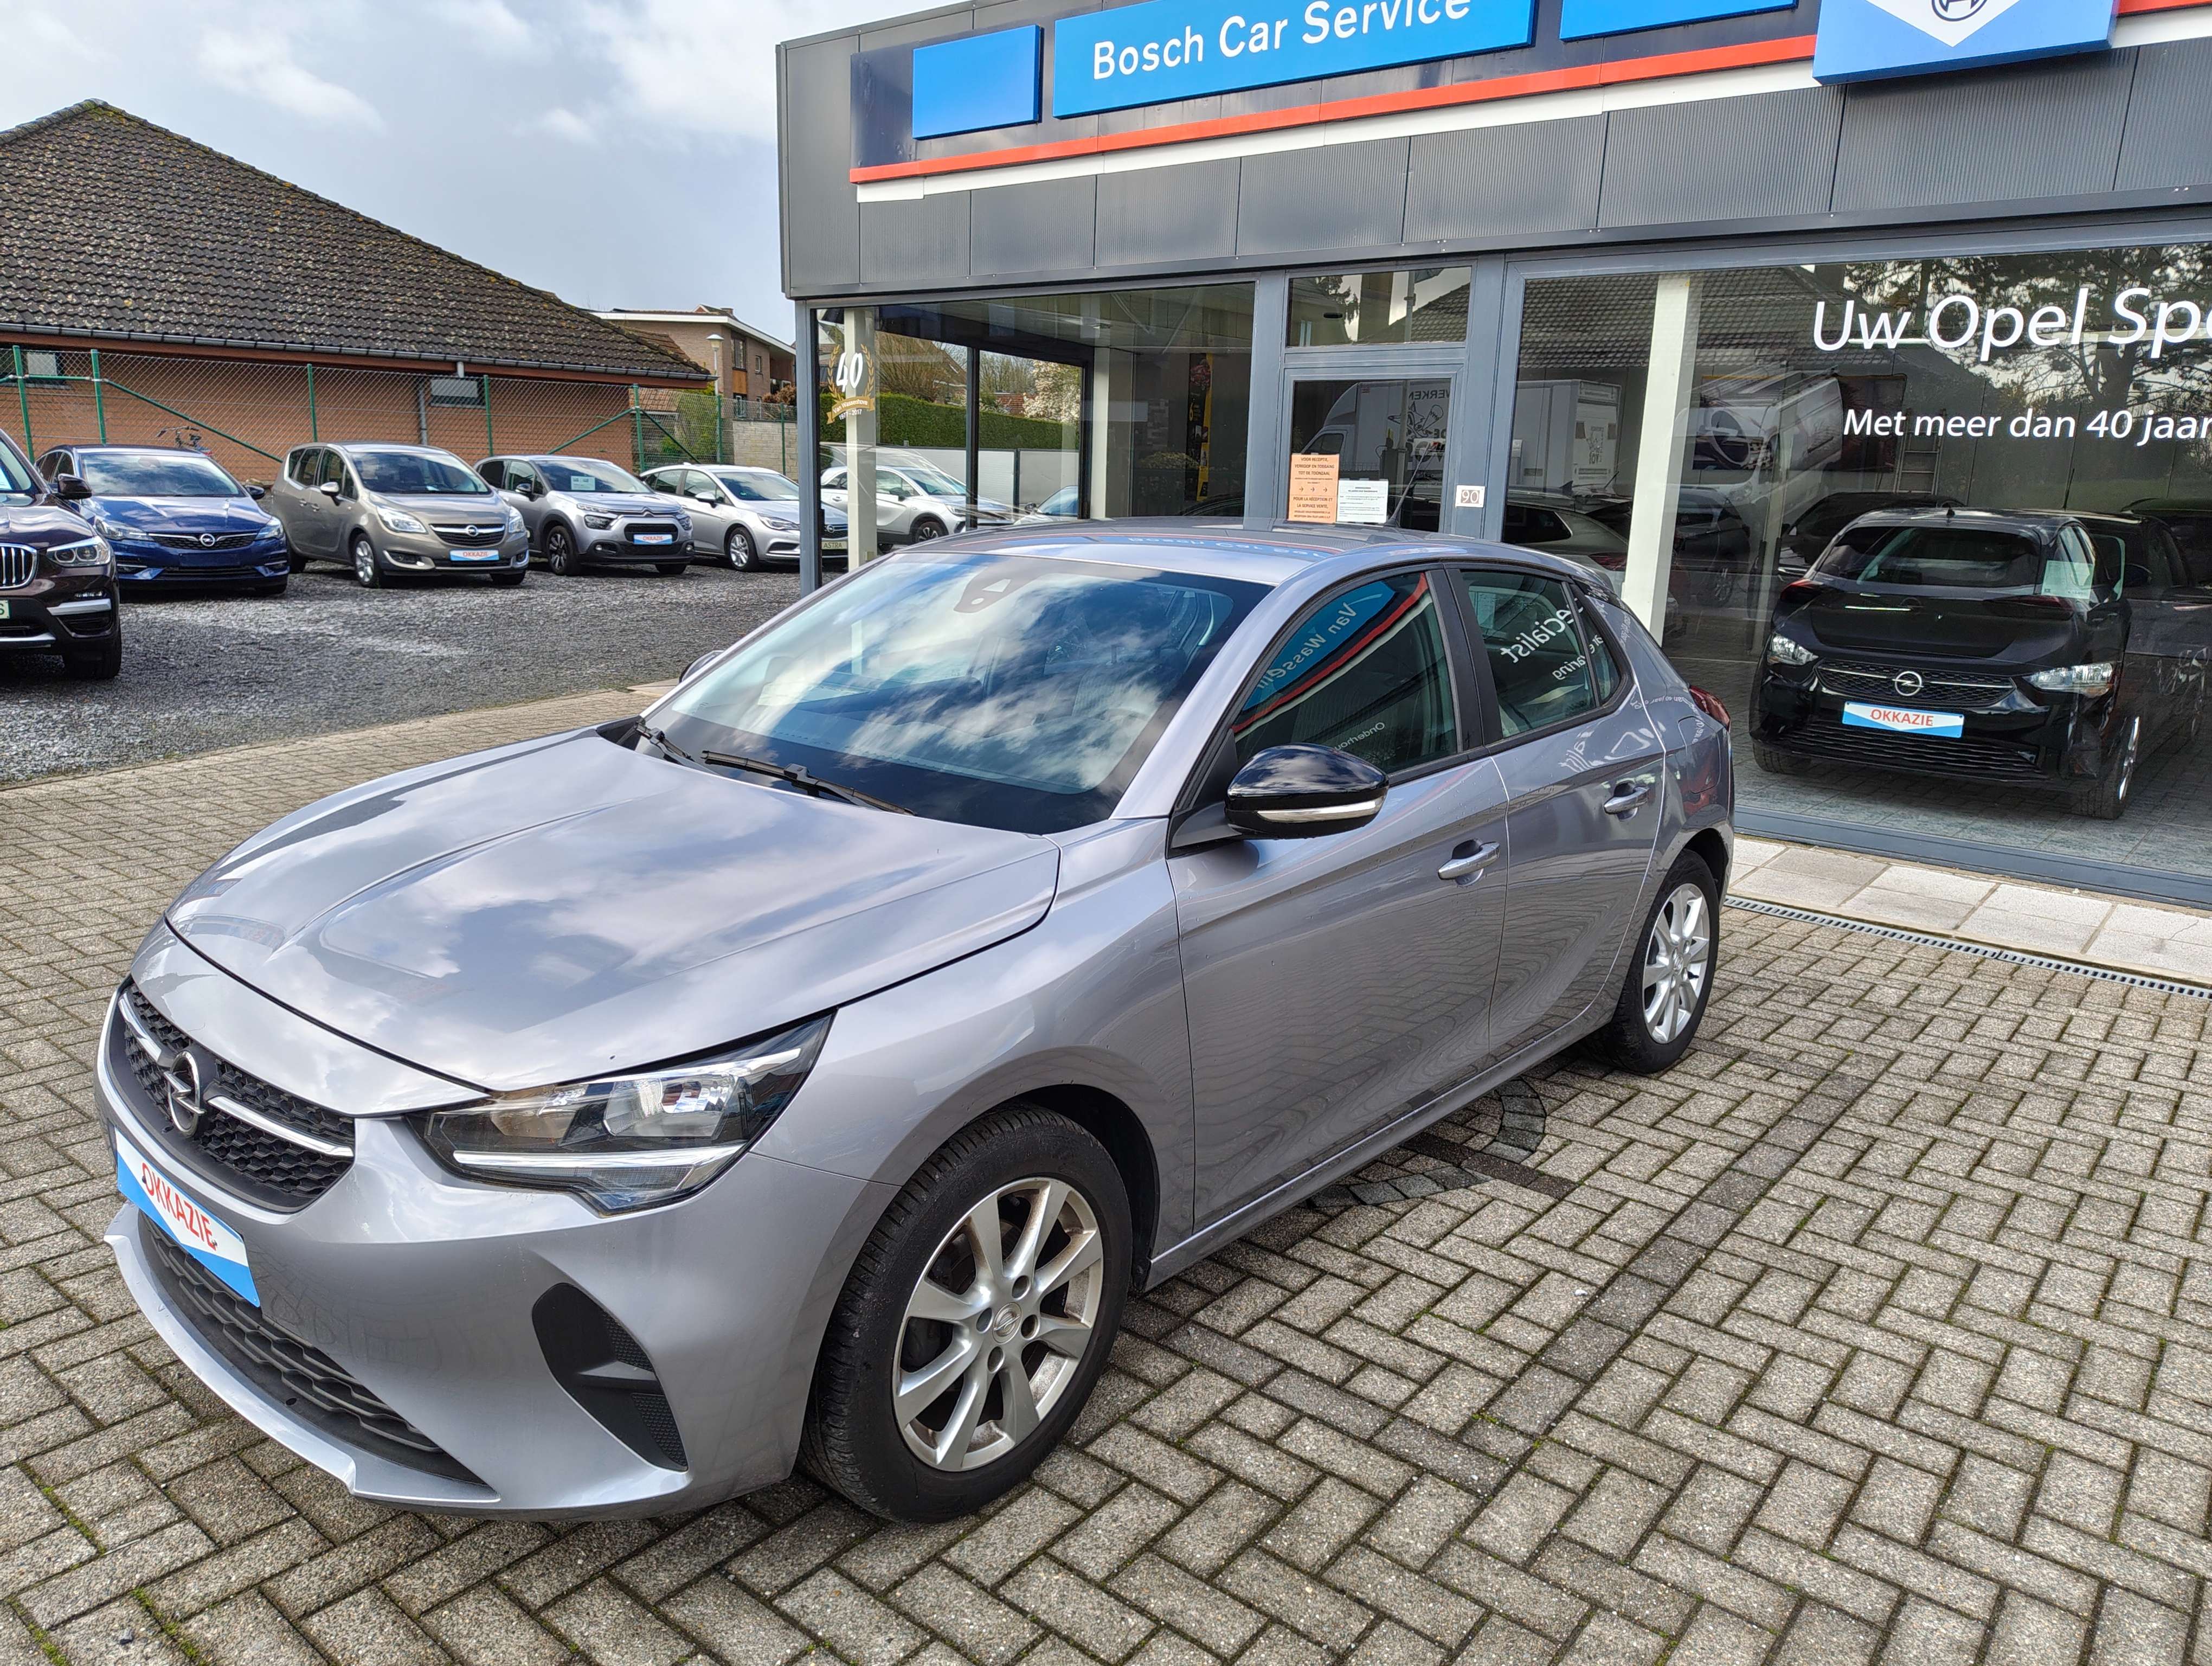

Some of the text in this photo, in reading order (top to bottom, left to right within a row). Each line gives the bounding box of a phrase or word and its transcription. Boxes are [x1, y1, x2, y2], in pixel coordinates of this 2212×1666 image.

[1094, 0, 1470, 80] Bosch Car Service
[1813, 299, 1912, 351] Uw
[1928, 287, 2088, 362] Opel
[836, 352, 863, 392] 40
[832, 406, 842, 414] Van
[1843, 408, 2212, 446] Met meer dan 40 jaar
[1462, 490, 1480, 503] 90
[1870, 708, 1933, 727] OKKAZIE
[142, 1162, 217, 1251] OKKAZIE
